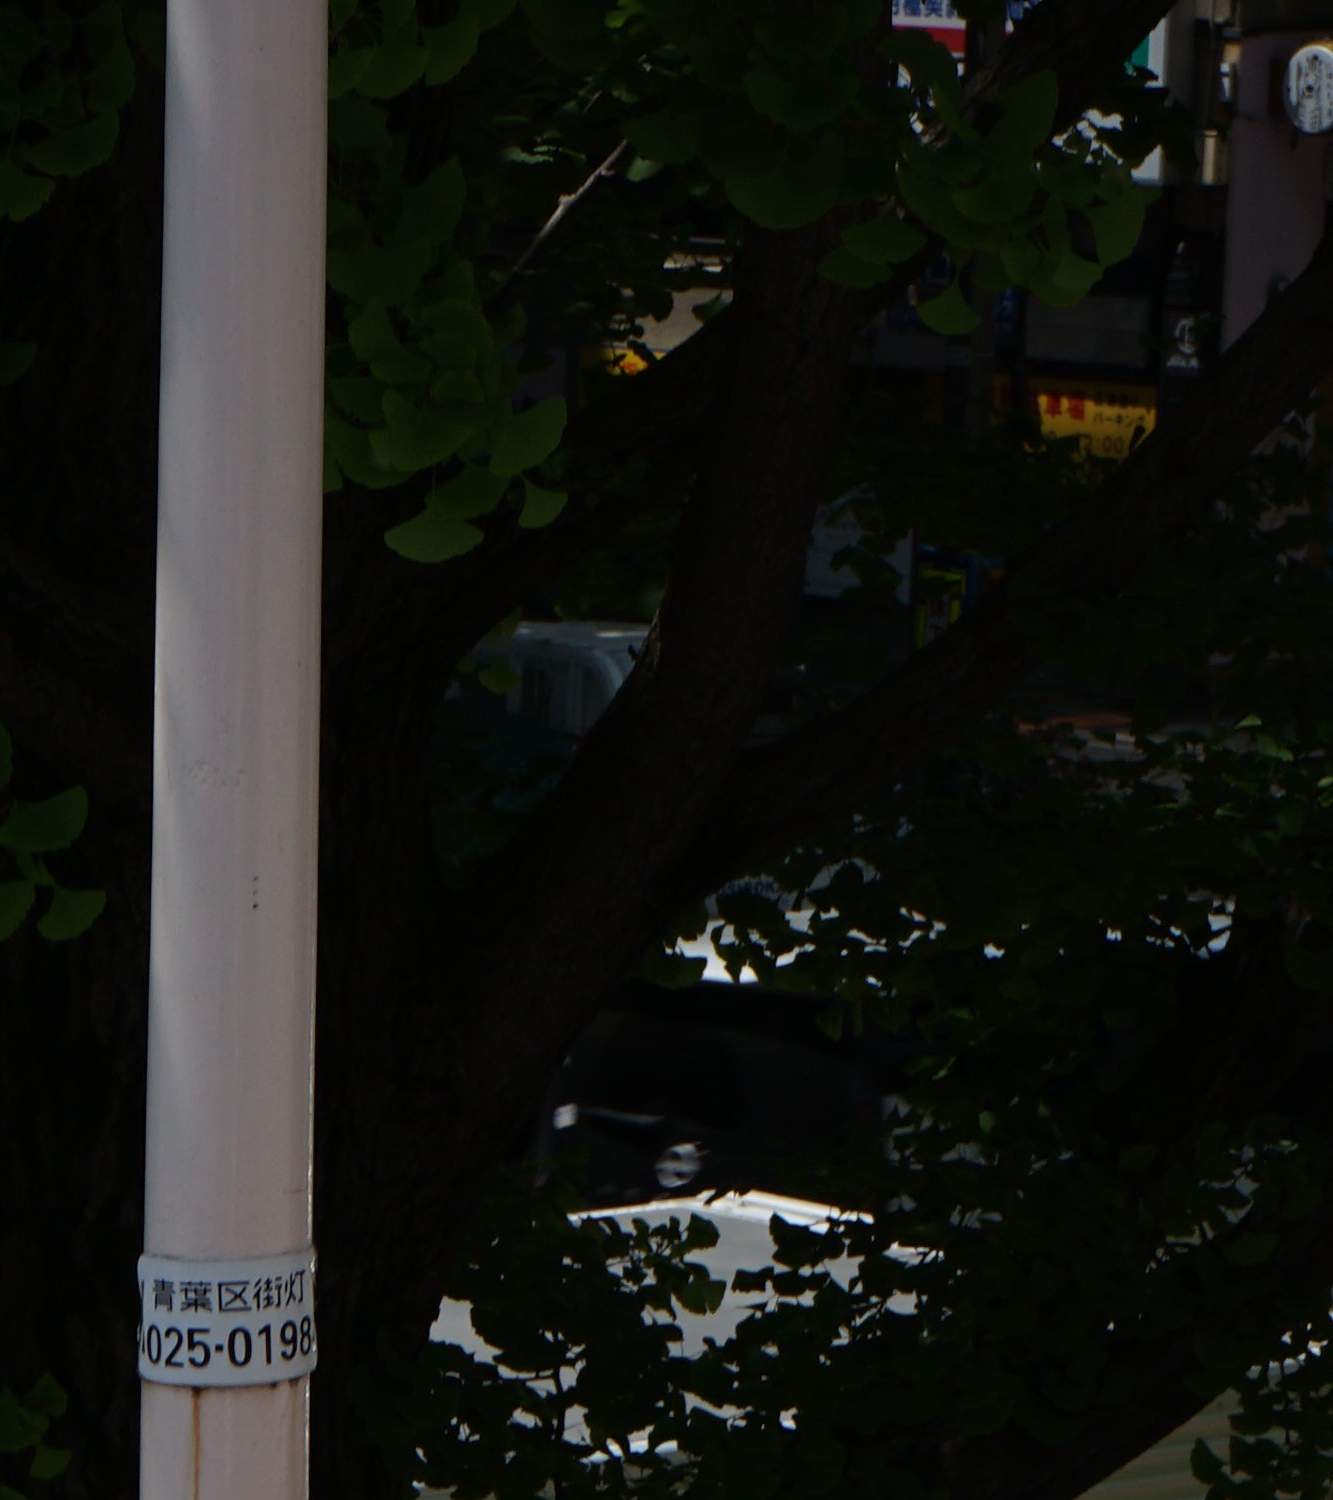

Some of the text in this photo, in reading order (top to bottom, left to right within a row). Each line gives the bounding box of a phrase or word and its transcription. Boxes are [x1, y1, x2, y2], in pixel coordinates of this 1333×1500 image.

[153, 1269, 305, 1312] 青葉区街灯
